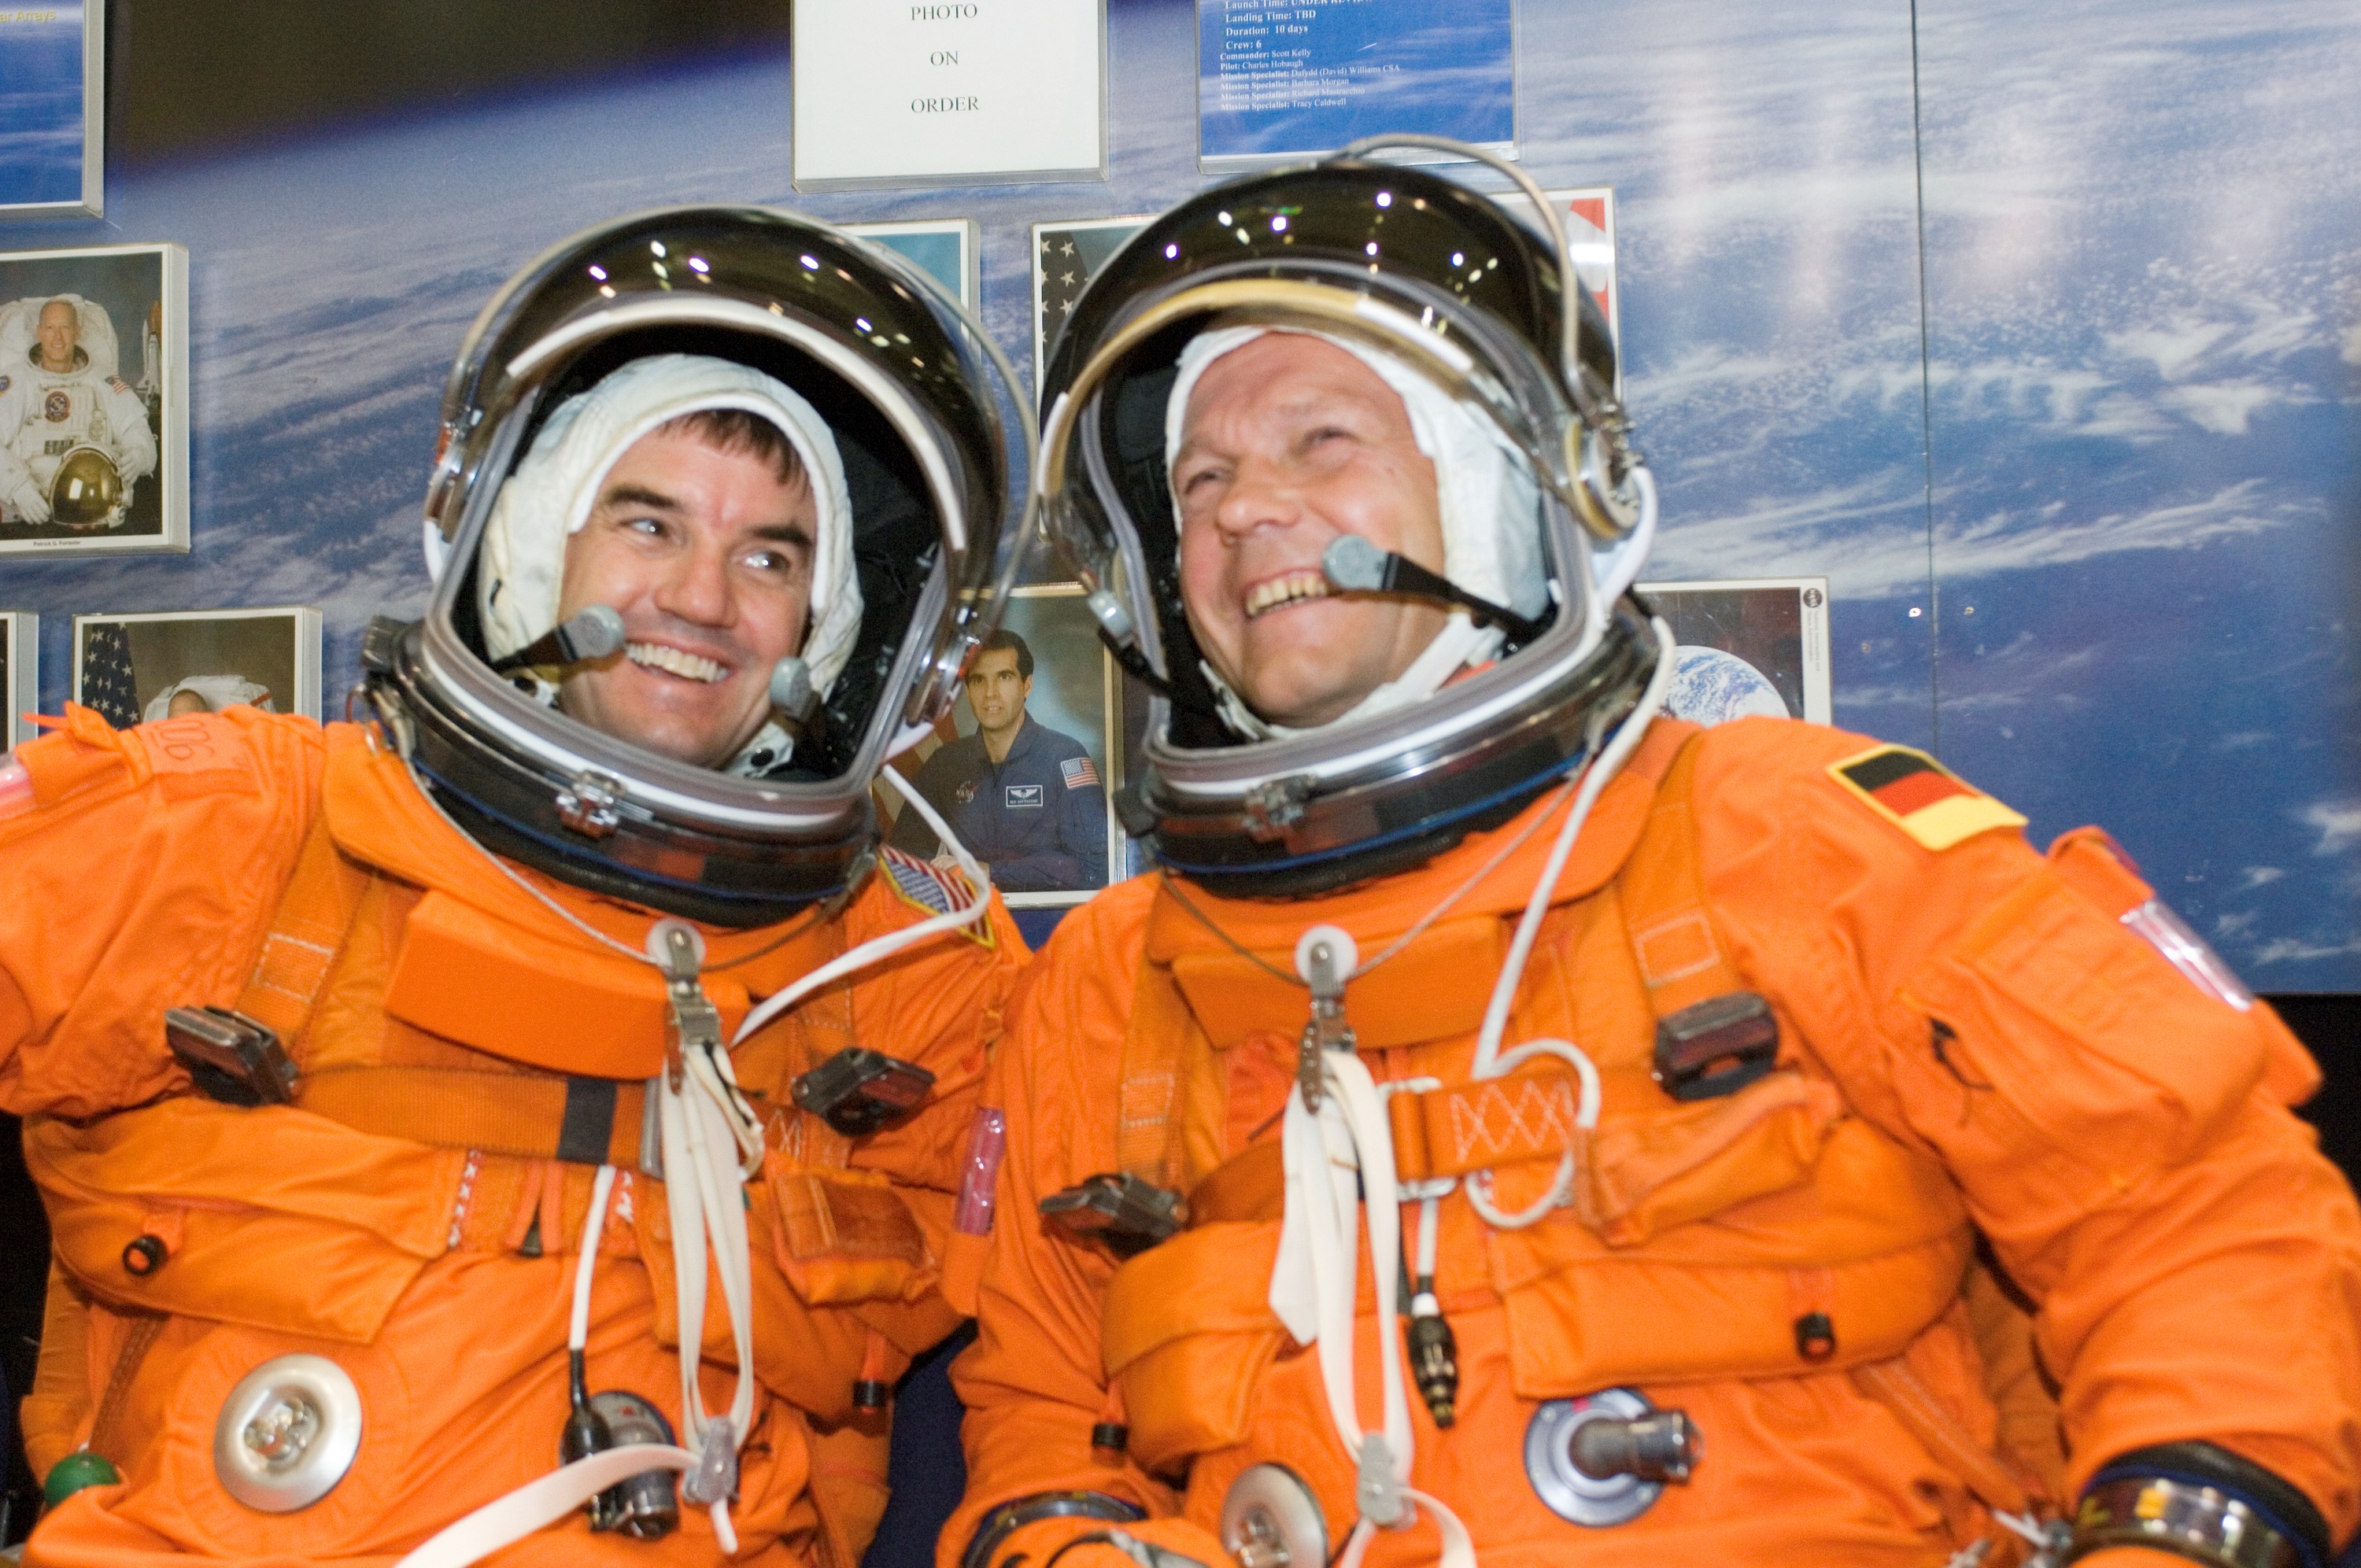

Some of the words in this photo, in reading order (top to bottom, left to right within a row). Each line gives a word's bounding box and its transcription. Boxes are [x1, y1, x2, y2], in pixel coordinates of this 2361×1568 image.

[1225, 0, 1259, 9] Launch
[16, 9, 57, 24] Arrays
[911, 3, 977, 20] PHOTO
[1225, 13, 1263, 23] Landing
[1265, 12, 1291, 21] Time:
[1295, 9, 1317, 19] TBD
[1225, 26, 1269, 36] Duration:
[1275, 25, 1285, 34] 10
[1288, 24, 1309, 35] days
[1225, 41, 1254, 50] Crew:
[1256, 39, 1262, 49] 6
[930, 50, 959, 66] ON
[1220, 51, 1269, 61] Commander:
[1291, 49, 1311, 57] Kelly
[1271, 59, 1303, 69] Hobaugh
[1251, 70, 1289, 81] Specialist:
[1291, 68, 1318, 78] Dafydd
[1319, 67, 1347, 76] (David)
[1349, 65, 1381, 74] Williams
[1382, 64, 1400, 72] CSA
[1221, 83, 1249, 91] Mission
[1251, 80, 1289, 90] Specialist:
[911, 96, 980, 113] ORDER
[1221, 102, 1250, 111] Mission
[1251, 101, 1290, 111] Specialist:
[1292, 100, 1312, 109] Tracy
[1314, 98, 1346, 107] Caldwell
